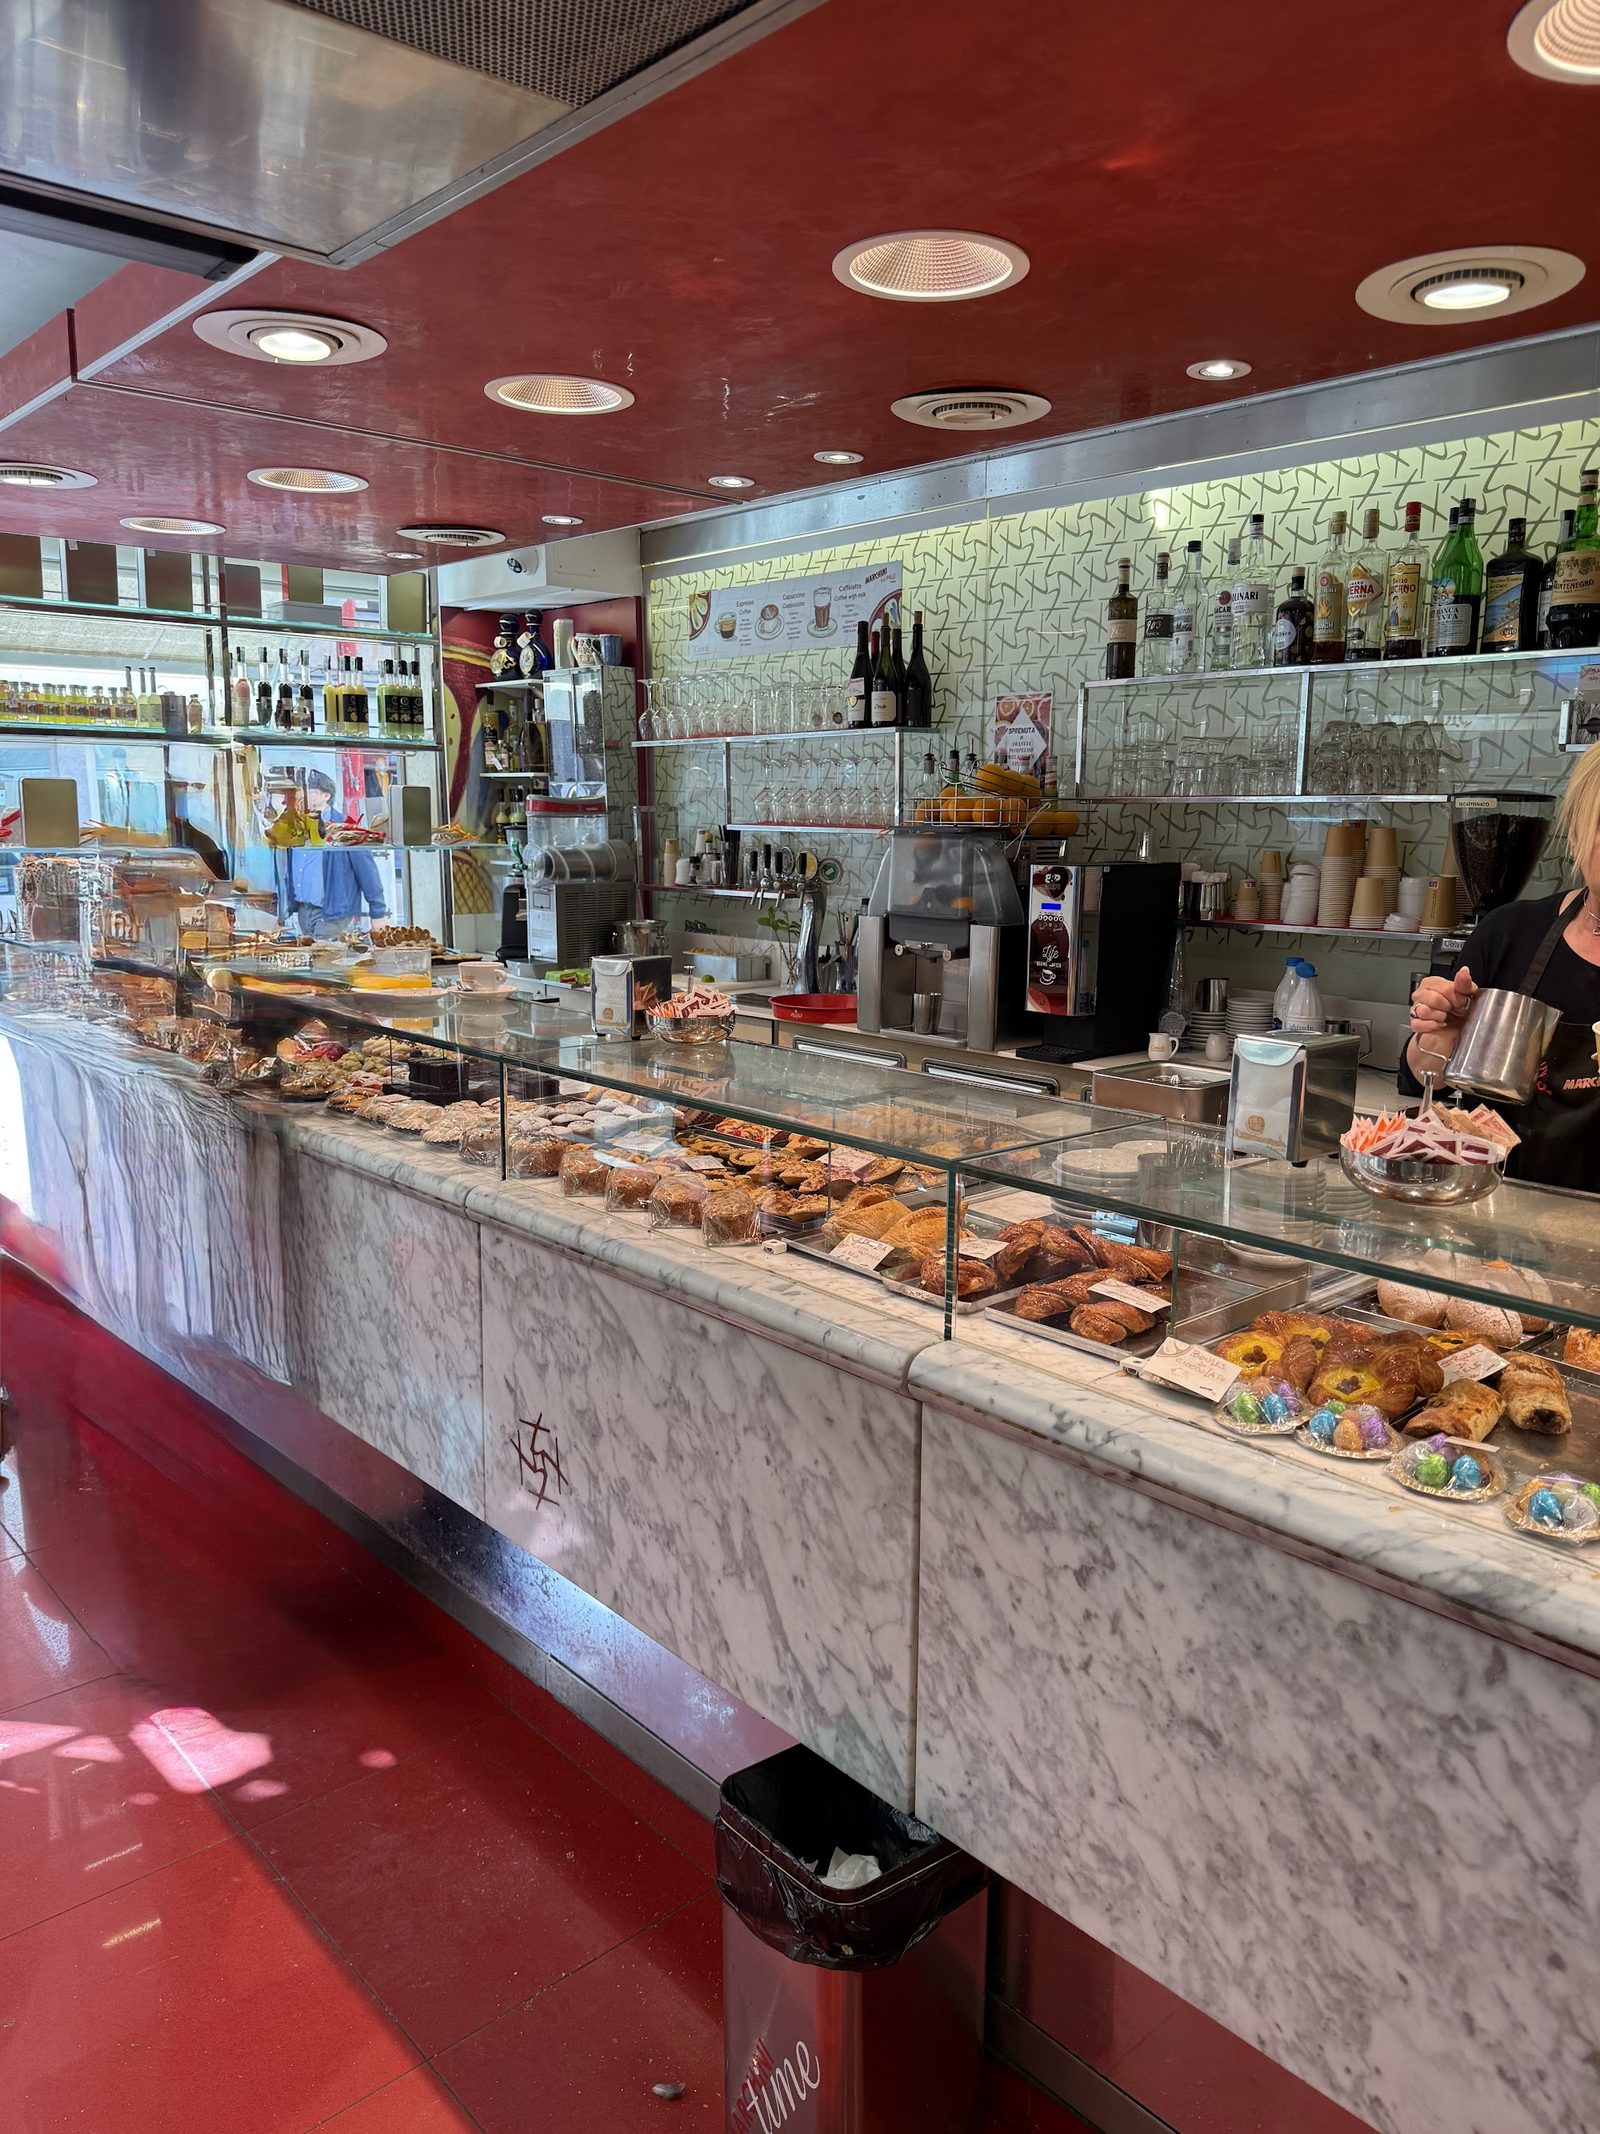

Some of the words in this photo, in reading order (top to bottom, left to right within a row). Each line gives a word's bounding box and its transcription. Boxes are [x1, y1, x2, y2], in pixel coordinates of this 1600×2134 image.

[1008, 727, 1036, 735] SPREMUTA
[1042, 945, 1060, 962] Life
[1563, 1077, 1600, 1090] MARC
[746, 2040, 821, 2134] time
